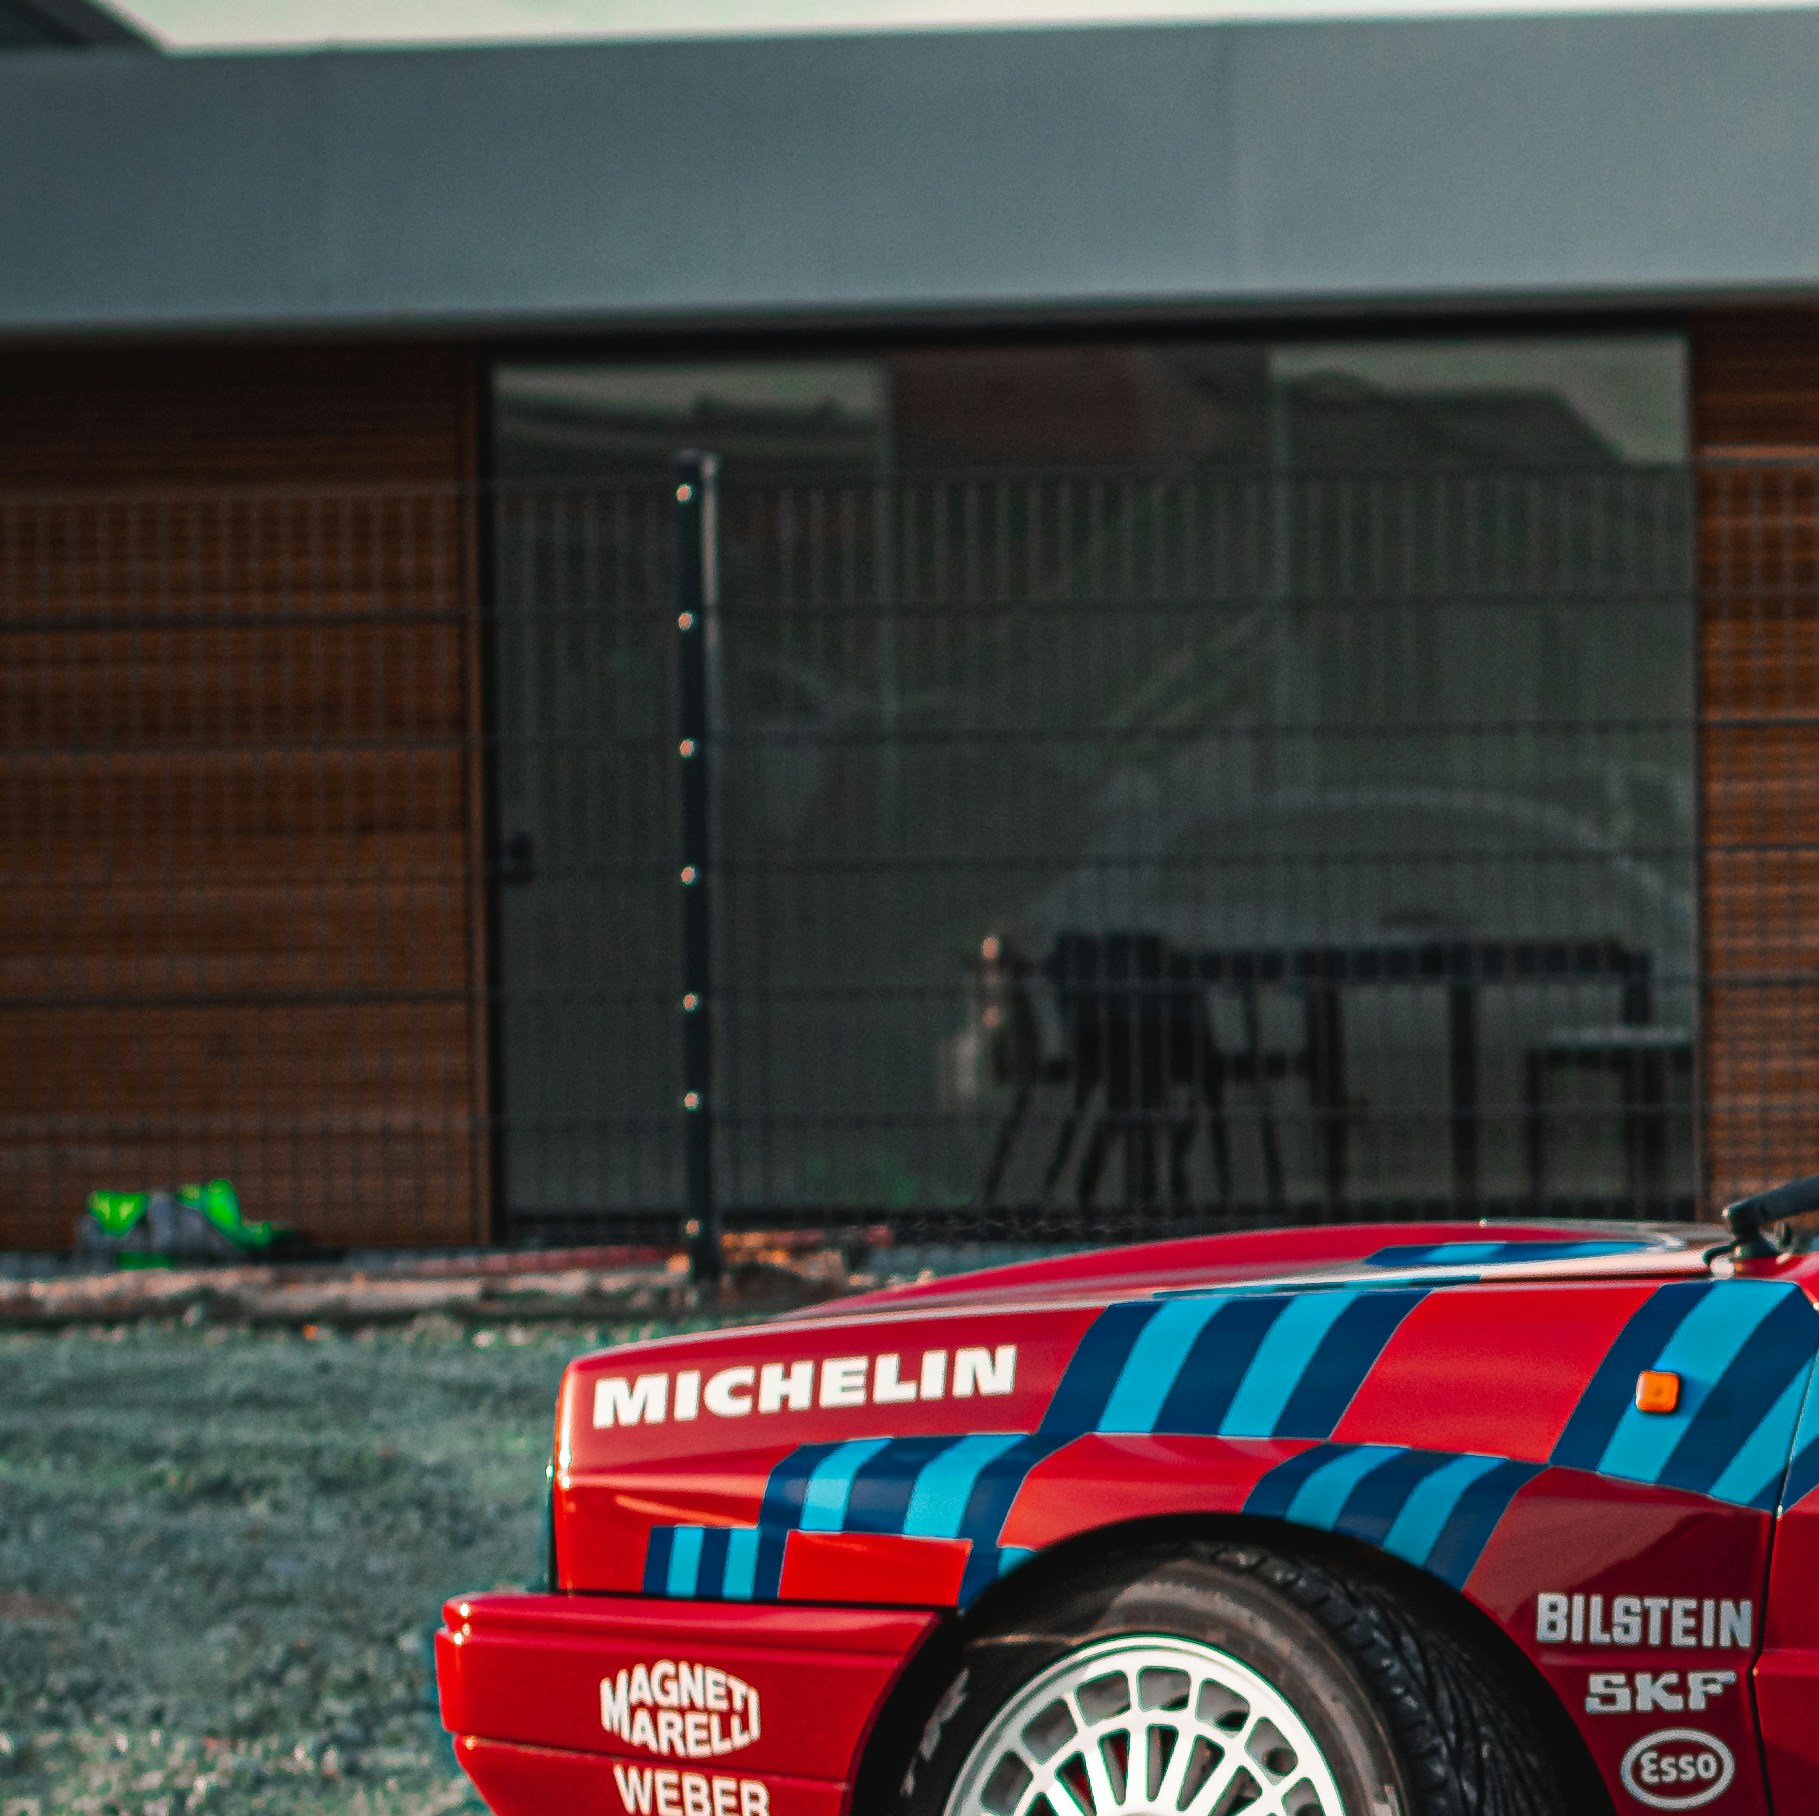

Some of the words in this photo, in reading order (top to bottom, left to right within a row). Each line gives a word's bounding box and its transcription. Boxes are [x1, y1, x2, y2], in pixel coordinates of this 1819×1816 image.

[592, 1345, 1017, 1429] MICHELIN
[1536, 1592, 1752, 1648] BILSTEIN
[600, 1659, 761, 1728] MAGNETI
[1585, 1670, 1736, 1713] SKF
[600, 1690, 761, 1758] MARELLI
[1639, 1752, 1717, 1784] Esso
